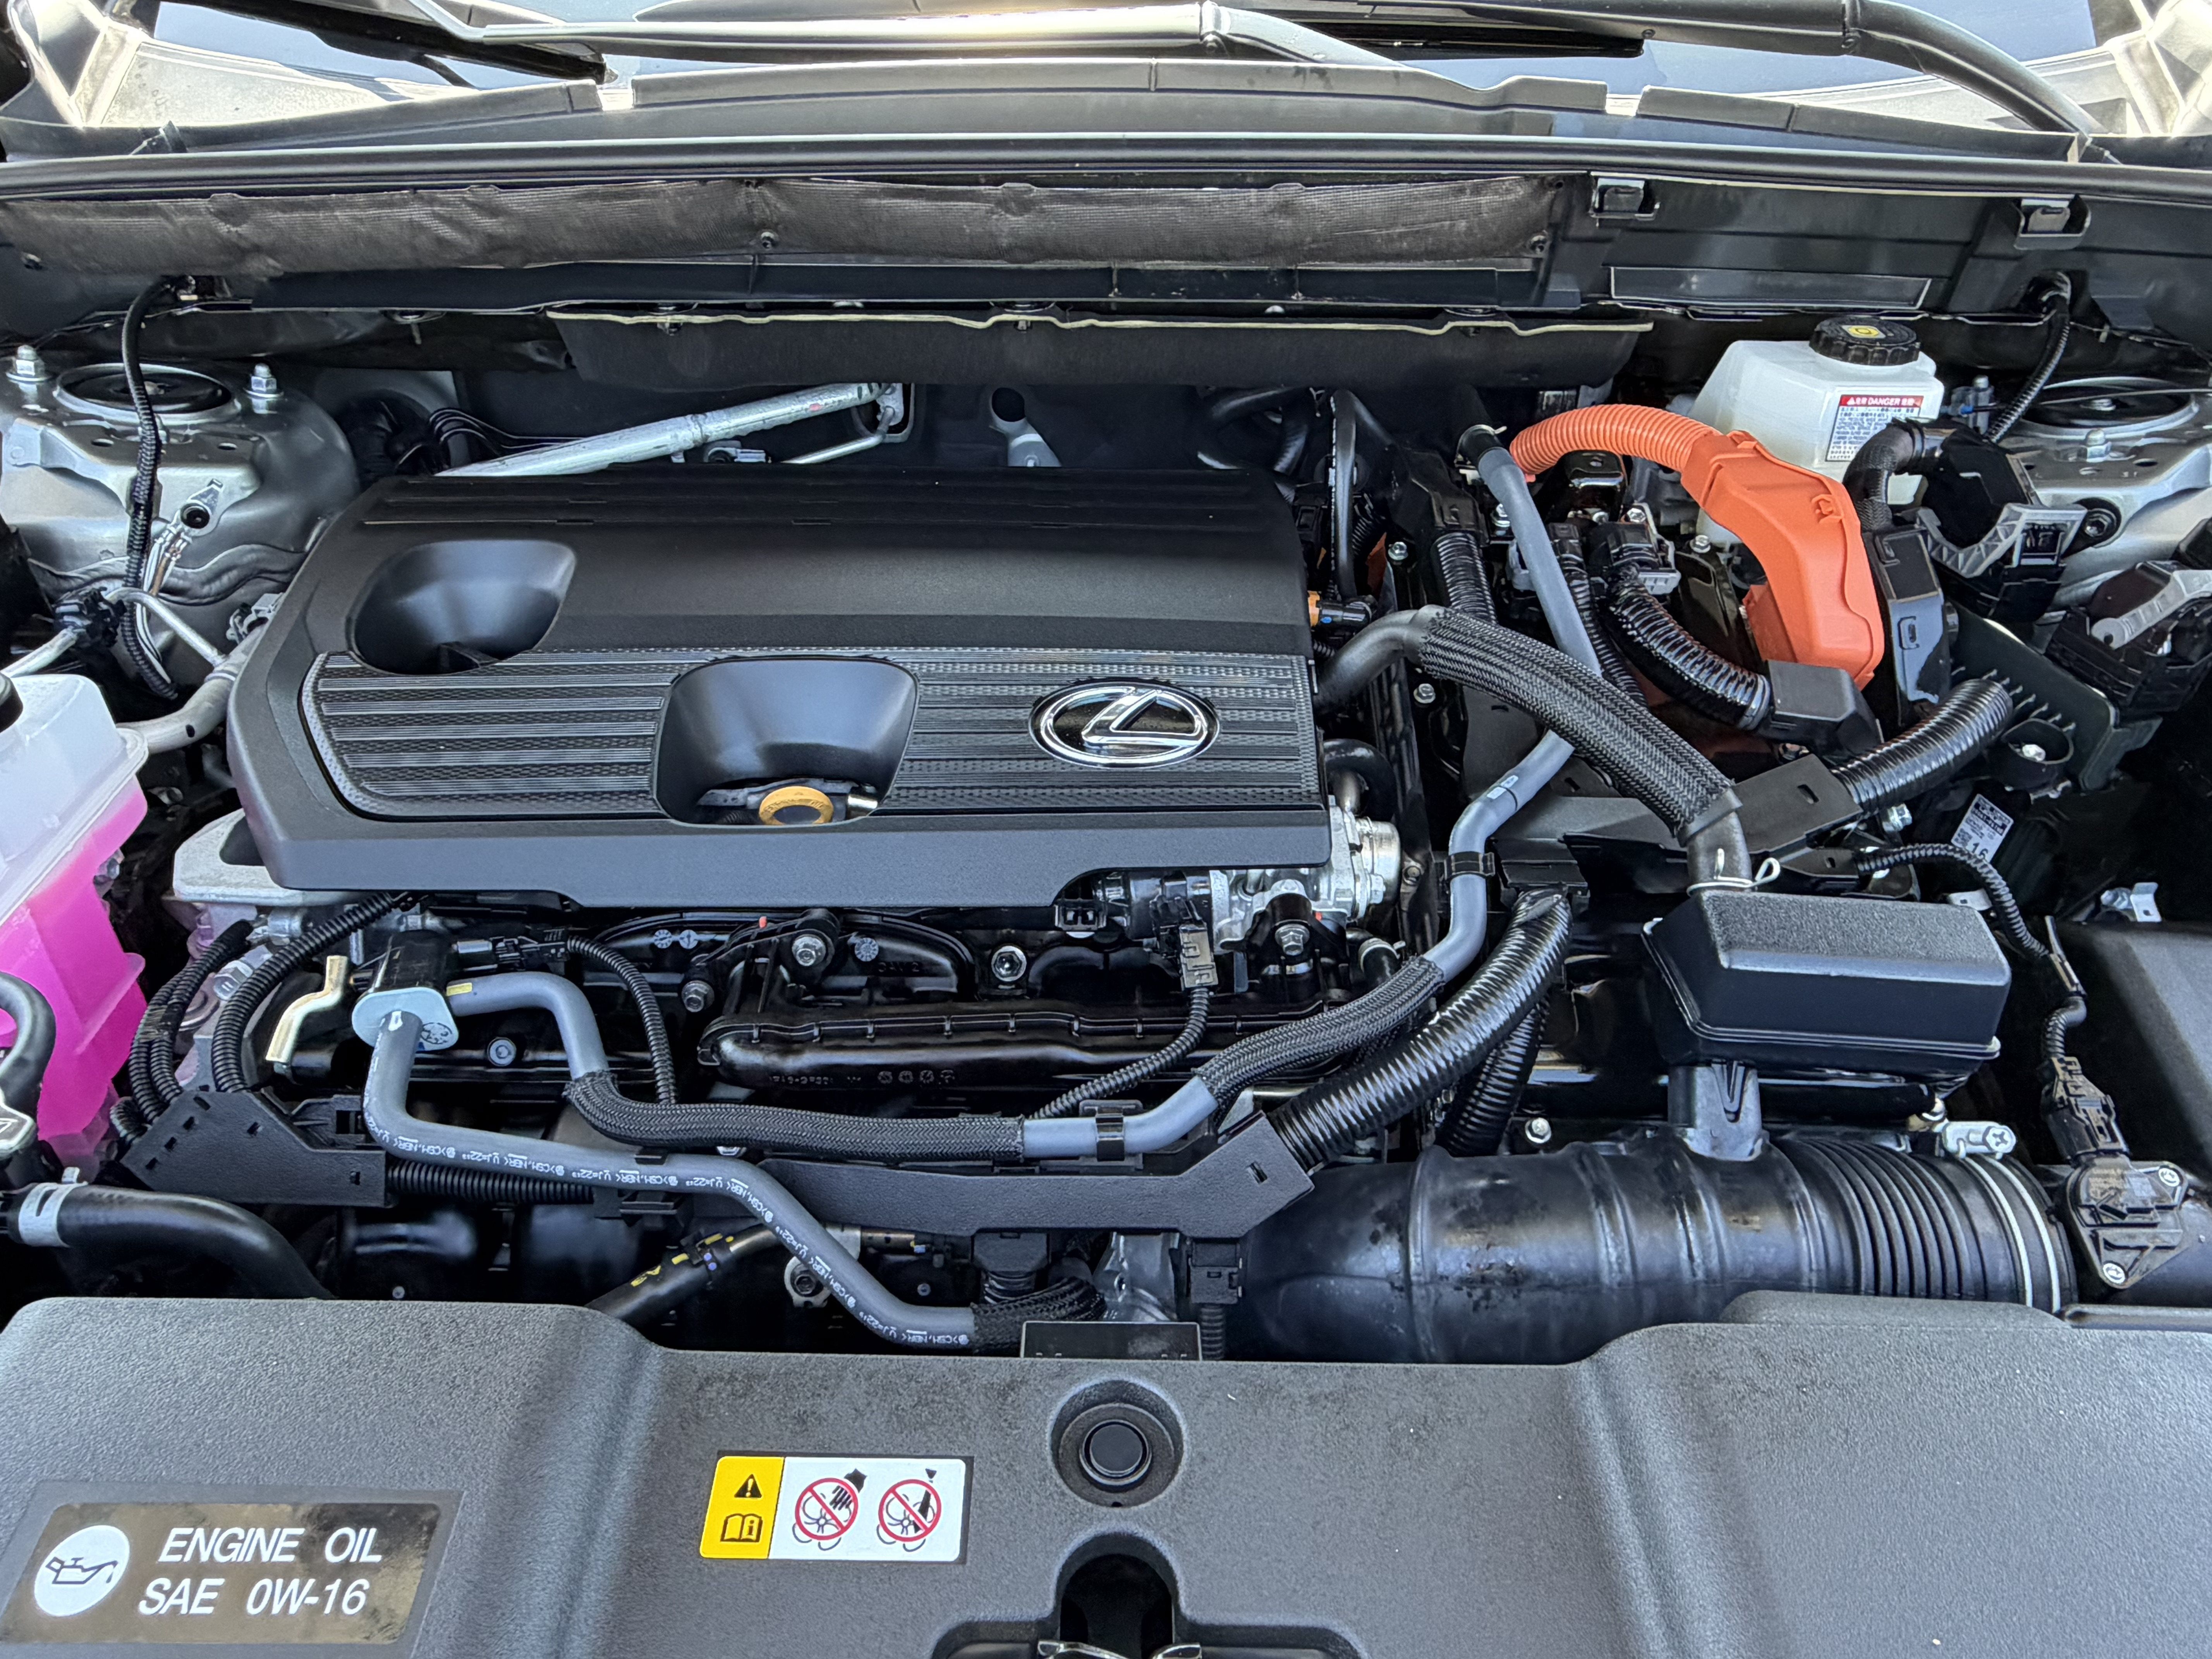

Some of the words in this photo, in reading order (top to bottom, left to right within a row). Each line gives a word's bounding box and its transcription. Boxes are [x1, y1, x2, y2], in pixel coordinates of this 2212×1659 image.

[158, 1527, 306, 1563] ENGINE
[324, 1527, 382, 1563] OIL
[138, 1577, 225, 1615] SAE
[246, 1578, 370, 1615] 0W-16
